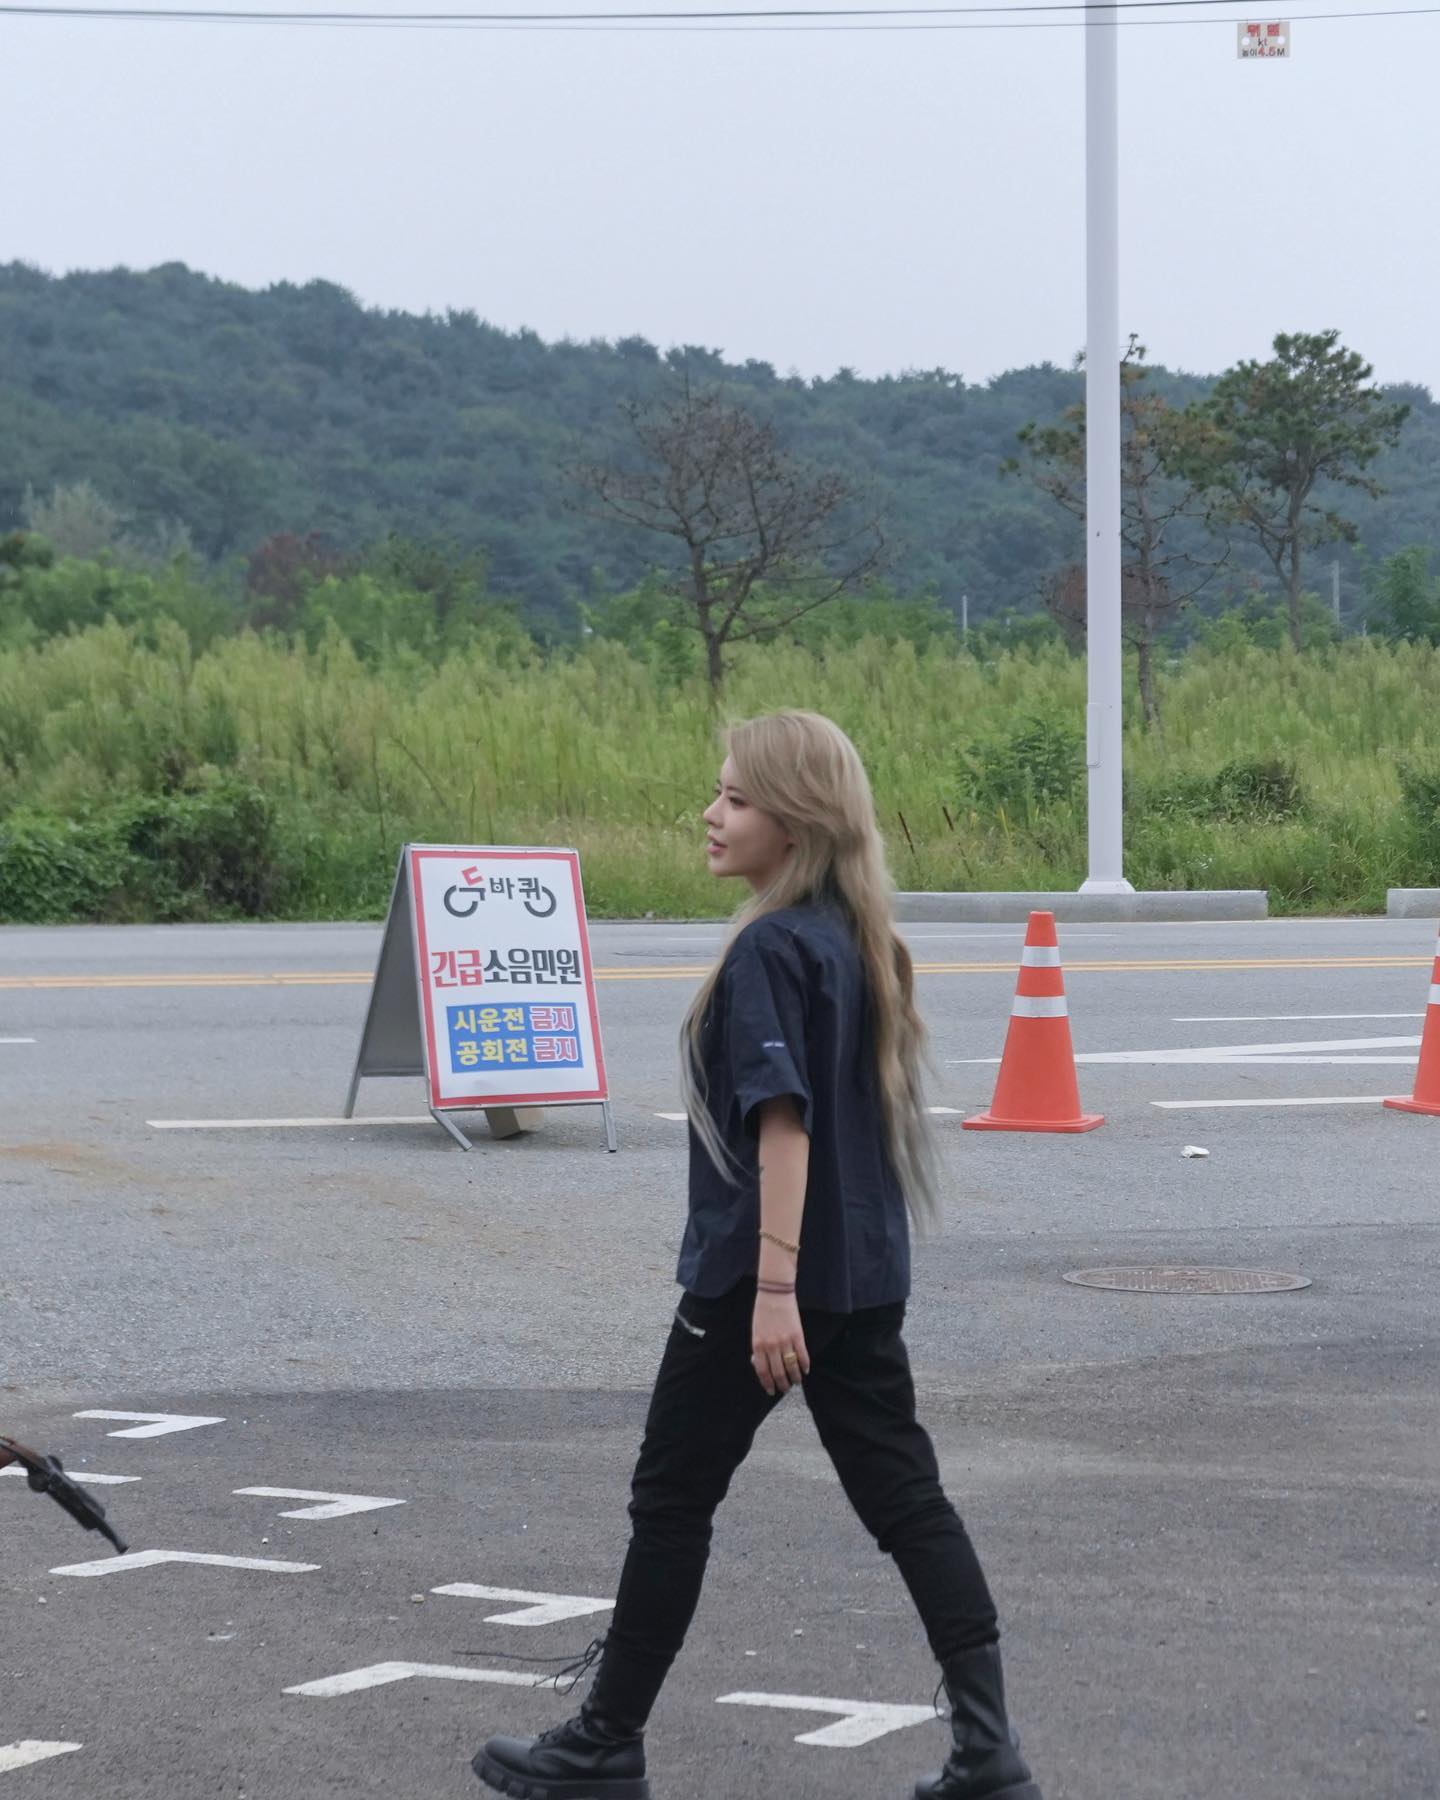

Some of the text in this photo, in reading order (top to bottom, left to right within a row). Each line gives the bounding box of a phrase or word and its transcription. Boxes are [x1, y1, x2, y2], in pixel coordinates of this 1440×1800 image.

[454, 1005, 575, 1034] 시운전 금지
[457, 1036, 577, 1066] 공회전 금지
